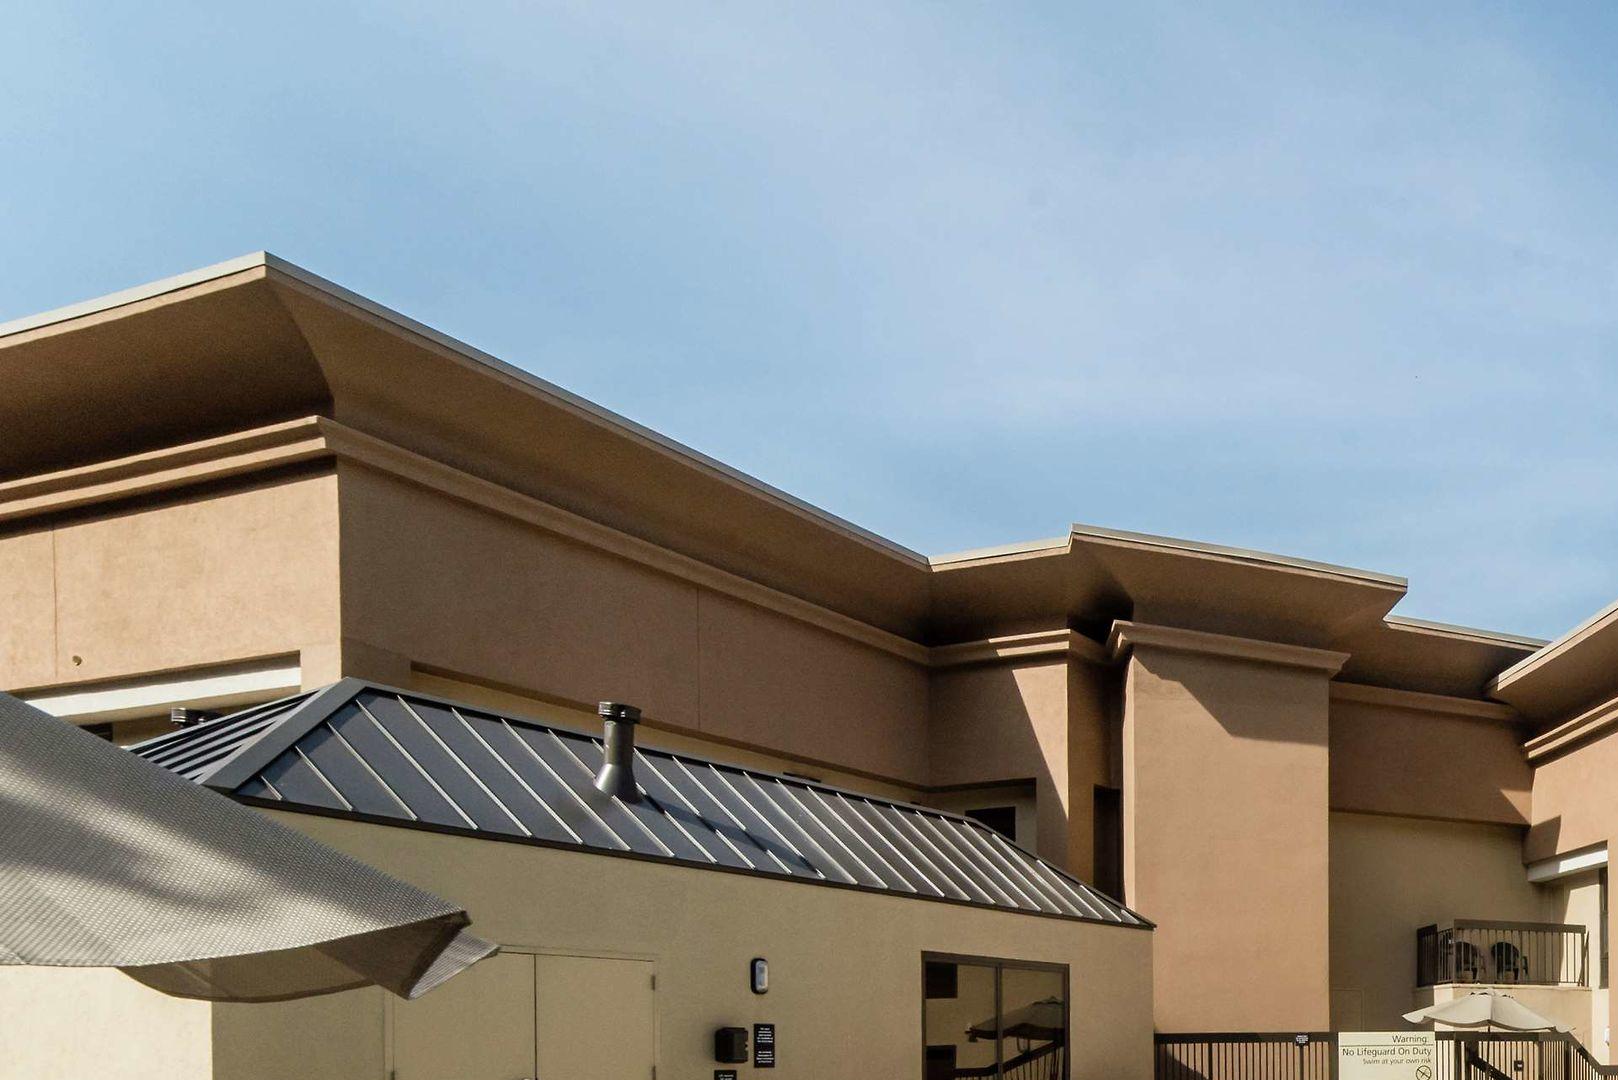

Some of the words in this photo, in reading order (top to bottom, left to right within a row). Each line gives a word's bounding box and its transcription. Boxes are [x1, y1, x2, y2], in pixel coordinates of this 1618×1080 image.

[1392, 1035, 1427, 1045] Warning
[1342, 1048, 1354, 1056] No
[1357, 1047, 1396, 1057] Lifeguard
[1398, 1047, 1410, 1056] On
[1412, 1047, 1432, 1057] Duty
